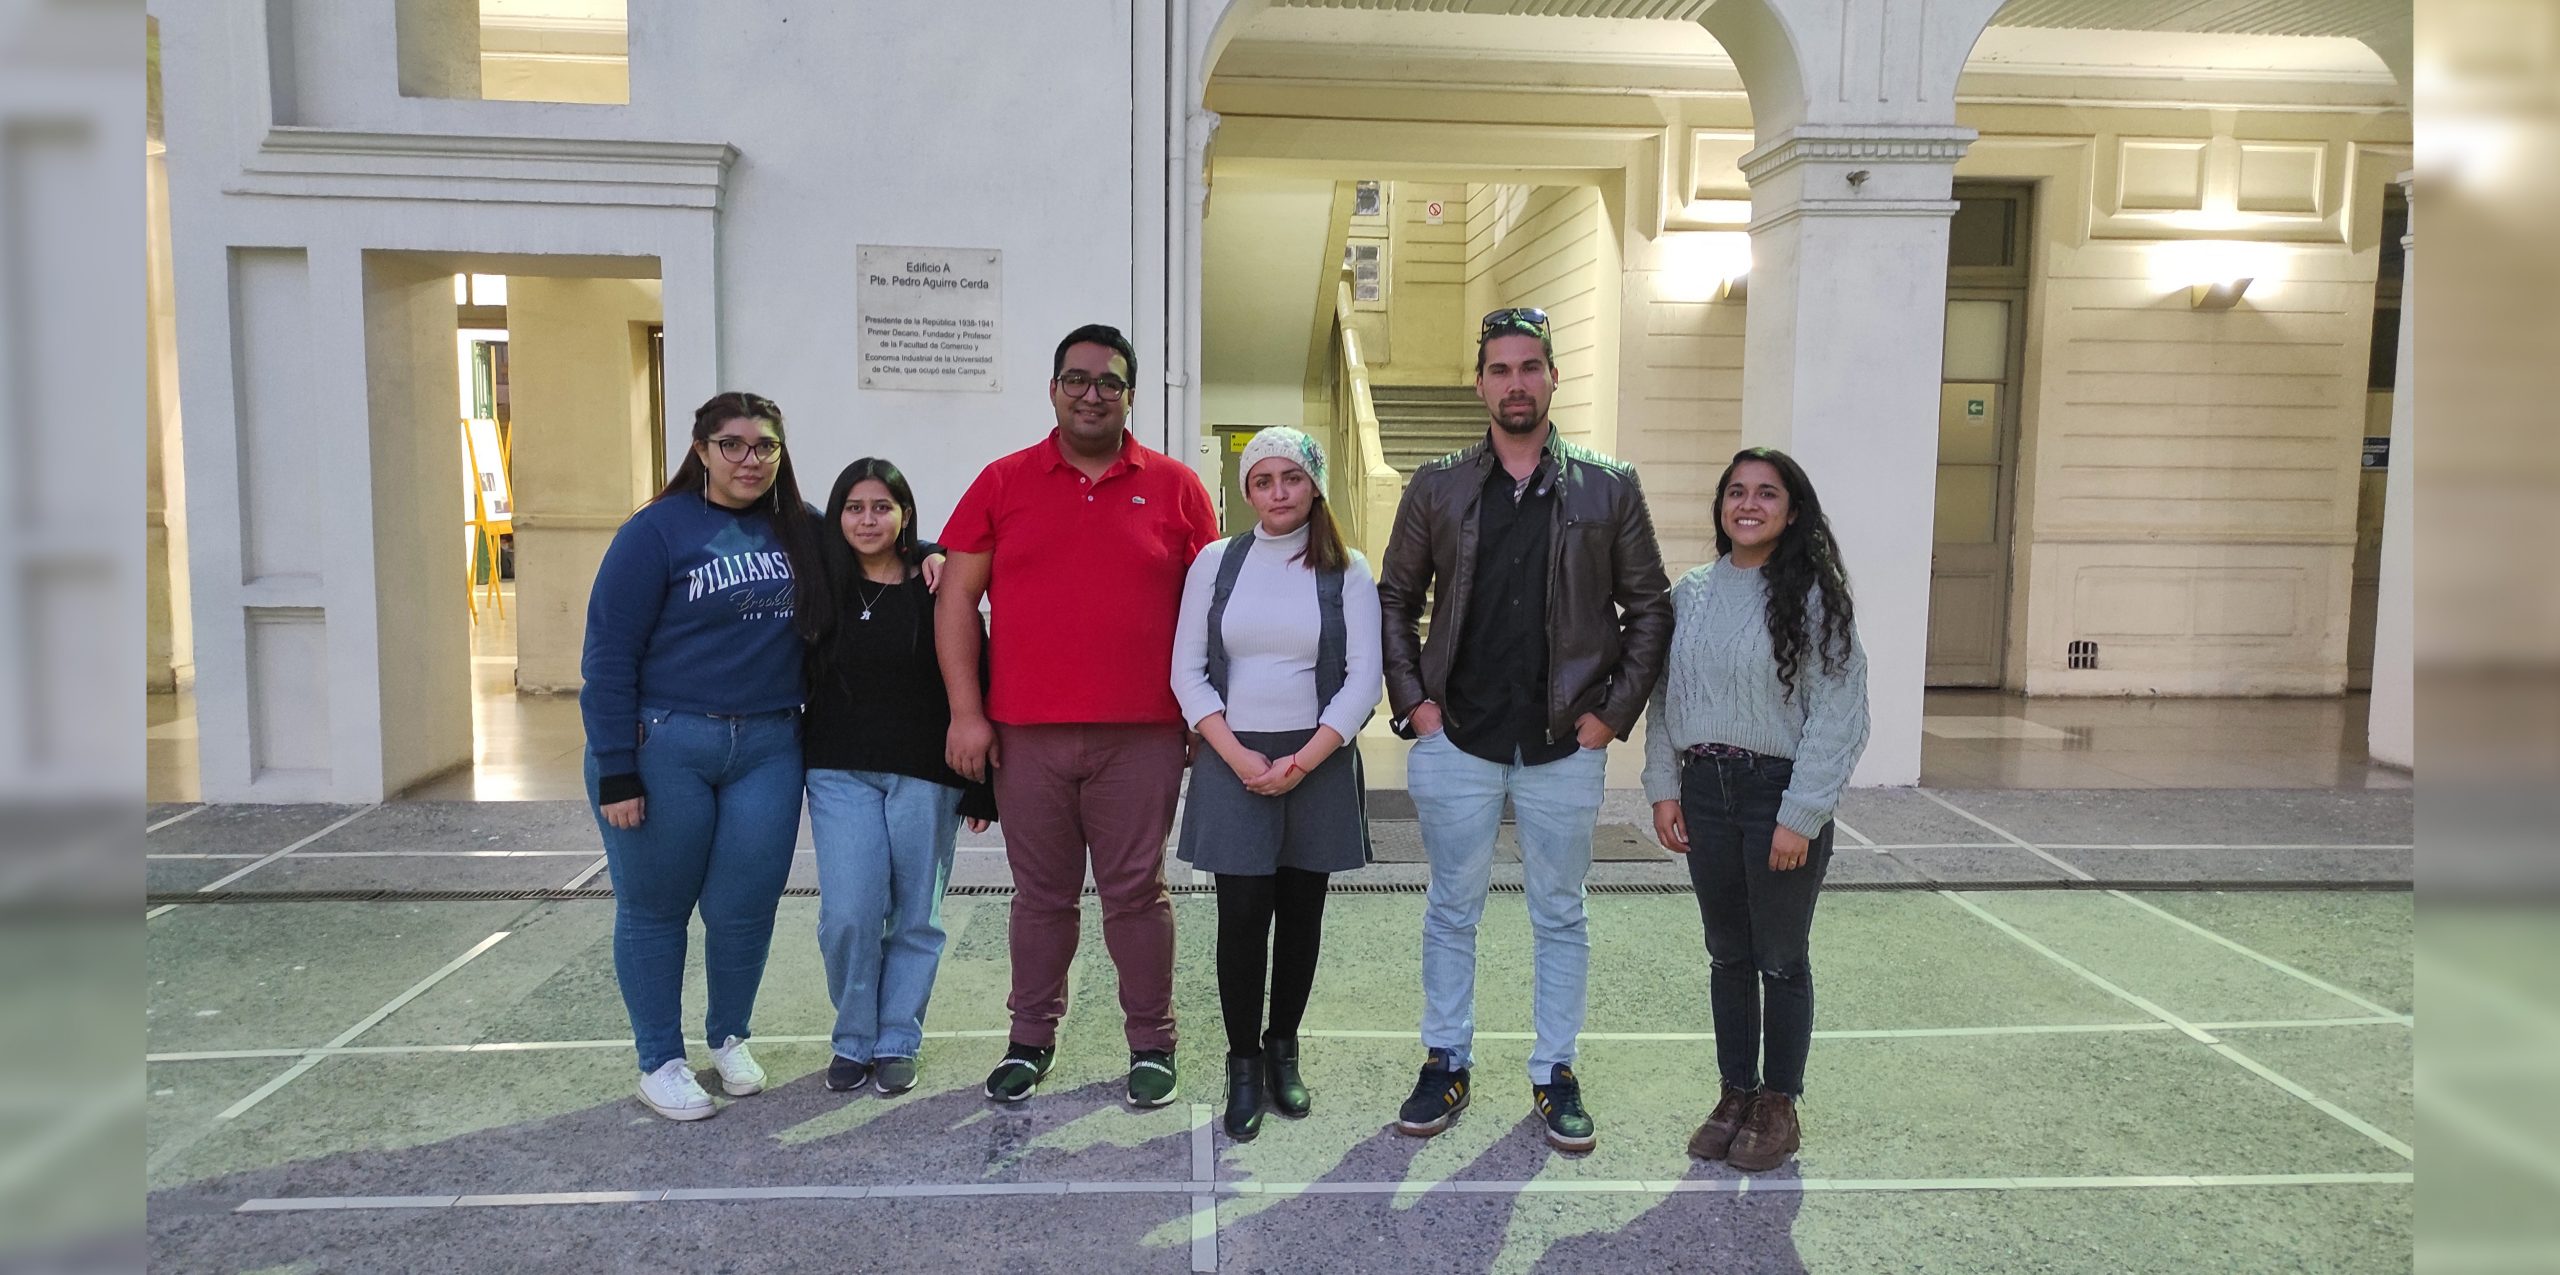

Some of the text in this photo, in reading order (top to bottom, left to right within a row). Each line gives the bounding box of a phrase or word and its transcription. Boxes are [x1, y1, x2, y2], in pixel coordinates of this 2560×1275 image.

[906, 261, 951, 273] Edificio A
[870, 274, 989, 290] Pte. Pedro Aguirre Cerda
[865, 315, 902, 324] Presidente
[903, 317, 913, 325] de
[914, 317, 921, 325] la
[959, 319, 994, 328] 1938-1941
[867, 327, 890, 336] Primer
[922, 329, 955, 338] Fundador
[957, 332, 961, 341] y
[962, 331, 992, 340] Profesor
[880, 340, 979, 352] de la Facultad de Comercio y
[901, 353, 933, 362] Industrial
[934, 354, 943, 363] de
[944, 354, 951, 363] la
[952, 354, 993, 364] Universidad
[903, 368, 917, 376] que
[941, 367, 956, 375] este
[957, 366, 987, 376] Campus
[687, 551, 796, 602] WILLIAMS
[728, 584, 796, 613] Brookly
